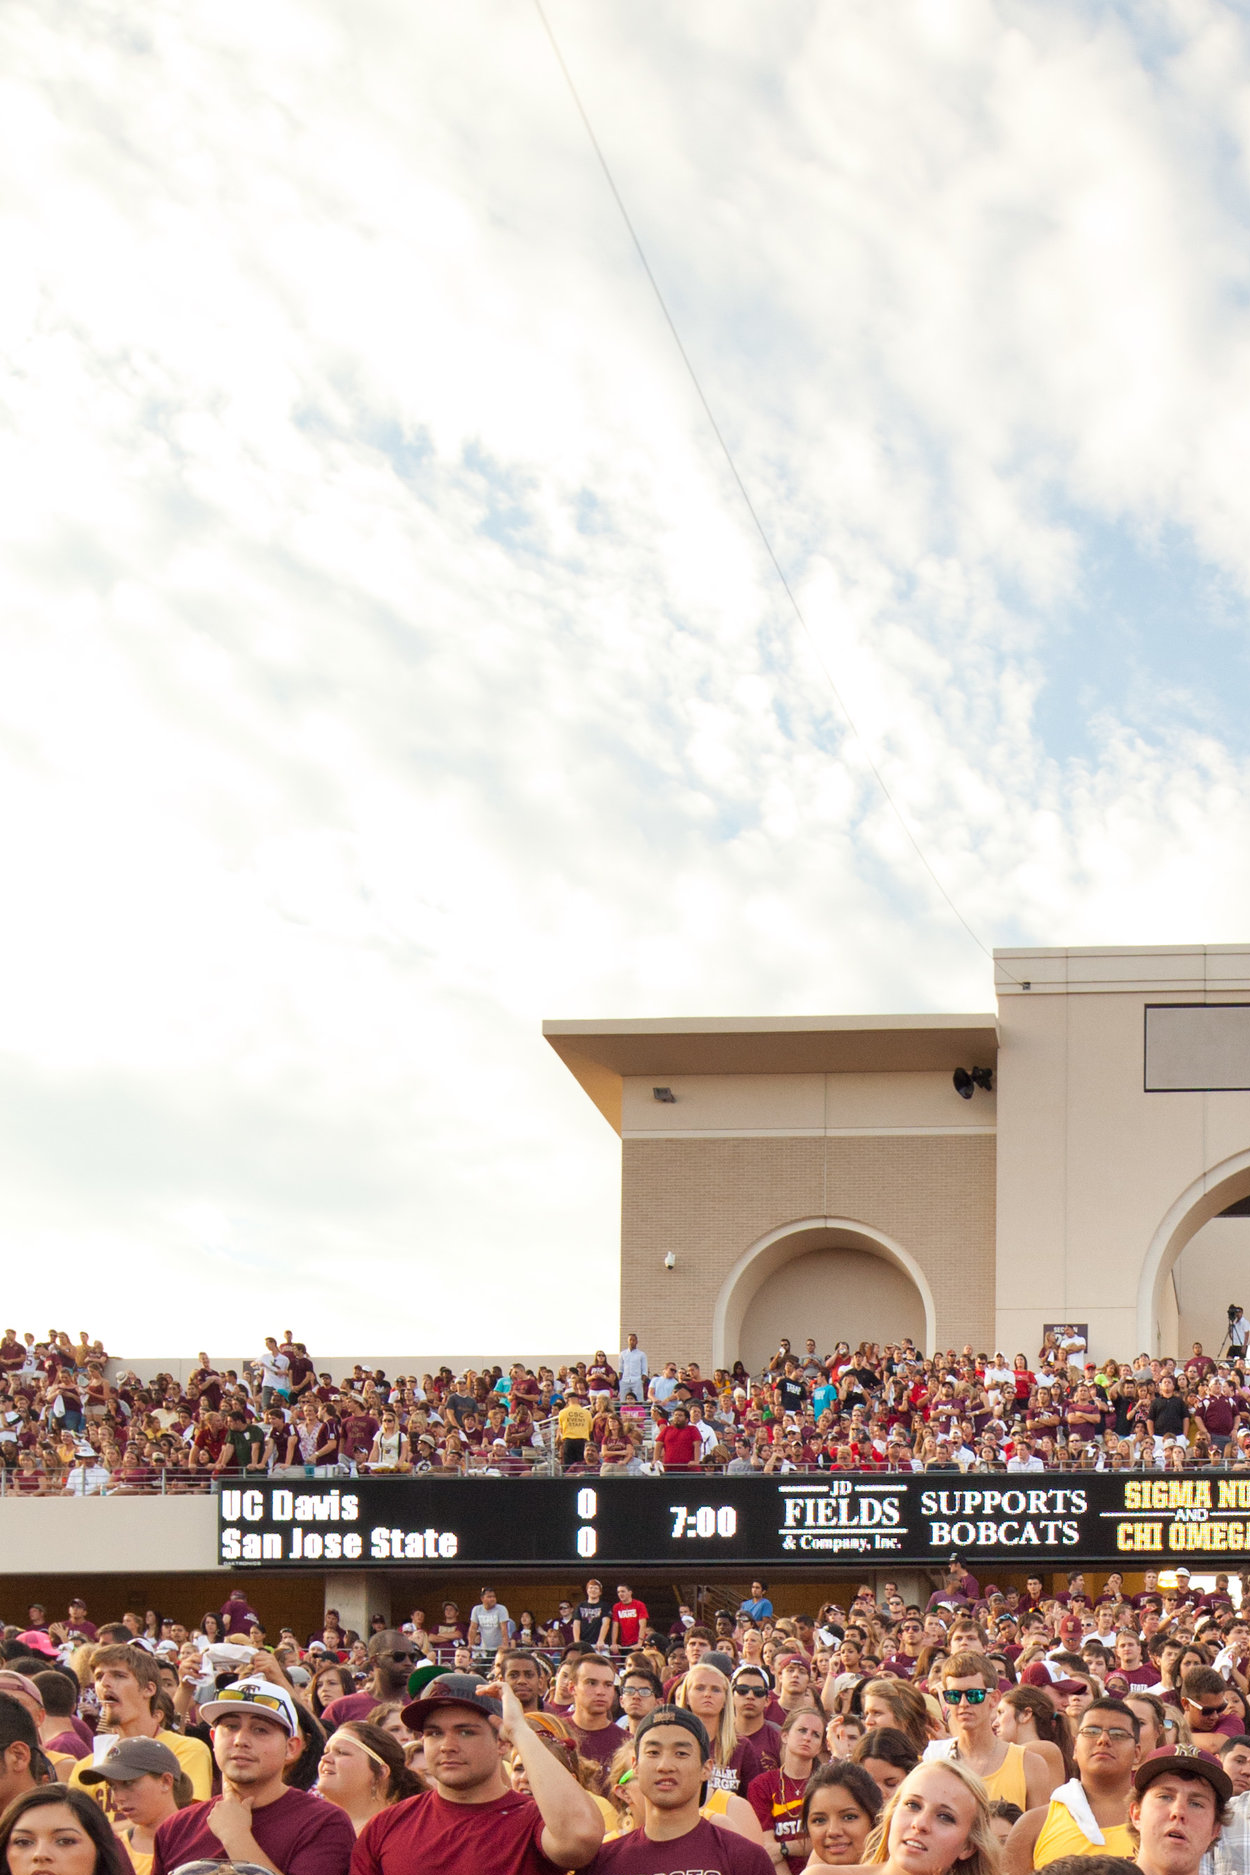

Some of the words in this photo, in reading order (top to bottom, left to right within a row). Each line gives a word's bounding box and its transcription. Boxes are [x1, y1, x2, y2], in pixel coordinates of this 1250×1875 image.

[577, 1488, 597, 1519] 0
[829, 1480, 852, 1497] JD
[921, 1489, 1088, 1515] SUPPORTS
[1125, 1480, 1212, 1509] SIGMA
[222, 1490, 263, 1521] UC
[272, 1490, 359, 1521] Davis
[784, 1497, 900, 1527] FIELDS
[1174, 1508, 1209, 1522] AND
[670, 1506, 737, 1538] 7:00
[930, 1520, 1080, 1546] BOBCATS
[1117, 1522, 1164, 1552] CHI
[222, 1528, 282, 1559] San
[289, 1528, 362, 1559] Jose
[371, 1527, 458, 1559] State
[577, 1526, 597, 1557] 0
[783, 1535, 797, 1550] &
[800, 1534, 872, 1553] Company,
[875, 1535, 902, 1550] Inc.
